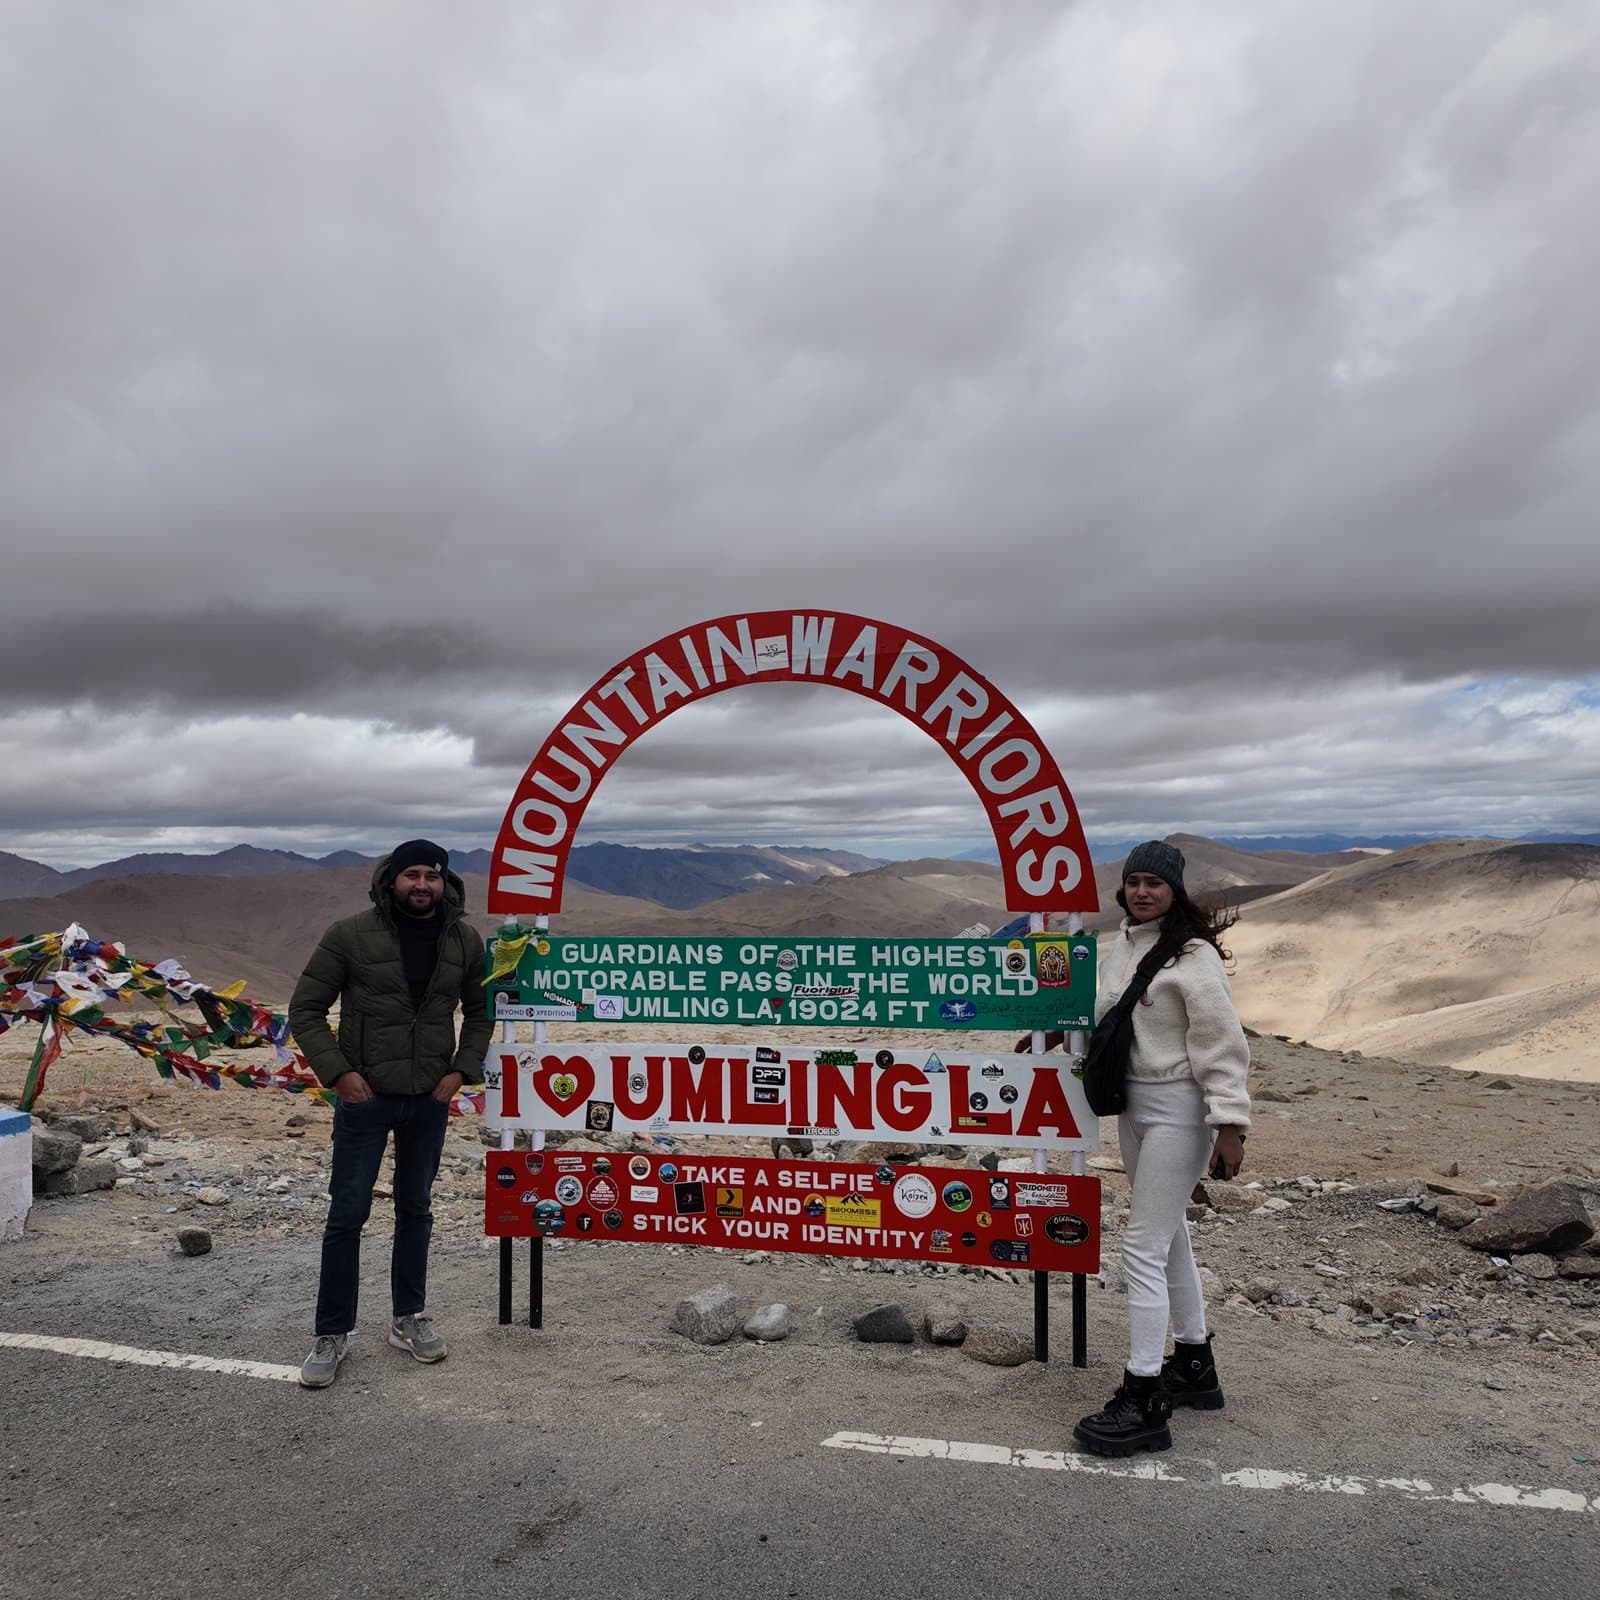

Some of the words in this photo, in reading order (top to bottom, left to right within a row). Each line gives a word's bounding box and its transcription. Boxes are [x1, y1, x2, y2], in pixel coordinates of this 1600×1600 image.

[497, 618, 757, 899] MOUNTAIN
[791, 615, 1082, 897] WARRIORS
[561, 943, 723, 965] GUARDIANS
[739, 944, 778, 965] OF
[795, 945, 856, 966] THE
[872, 946, 1007, 968] HIGHEST
[533, 970, 707, 992] MOTORABLE
[720, 972, 793, 993] PASS
[805, 972, 832, 987] IN
[847, 972, 910, 994] THE
[928, 973, 1039, 996] WORLD
[624, 997, 729, 1019] UMLING
[738, 998, 782, 1024] LA,
[789, 999, 878, 1022] 19024
[889, 1001, 929, 1023] FT
[500, 1055, 520, 1117] I
[610, 1056, 932, 1132] UMLING
[946, 1065, 1082, 1139] LA
[682, 1165, 745, 1186] TAKE
[754, 1169, 769, 1187] A
[778, 1170, 874, 1192] SELFIE
[750, 1196, 802, 1216] AND
[633, 1214, 708, 1236] STICK
[721, 1219, 789, 1241] YOUR
[802, 1223, 925, 1250] IDENTITY
